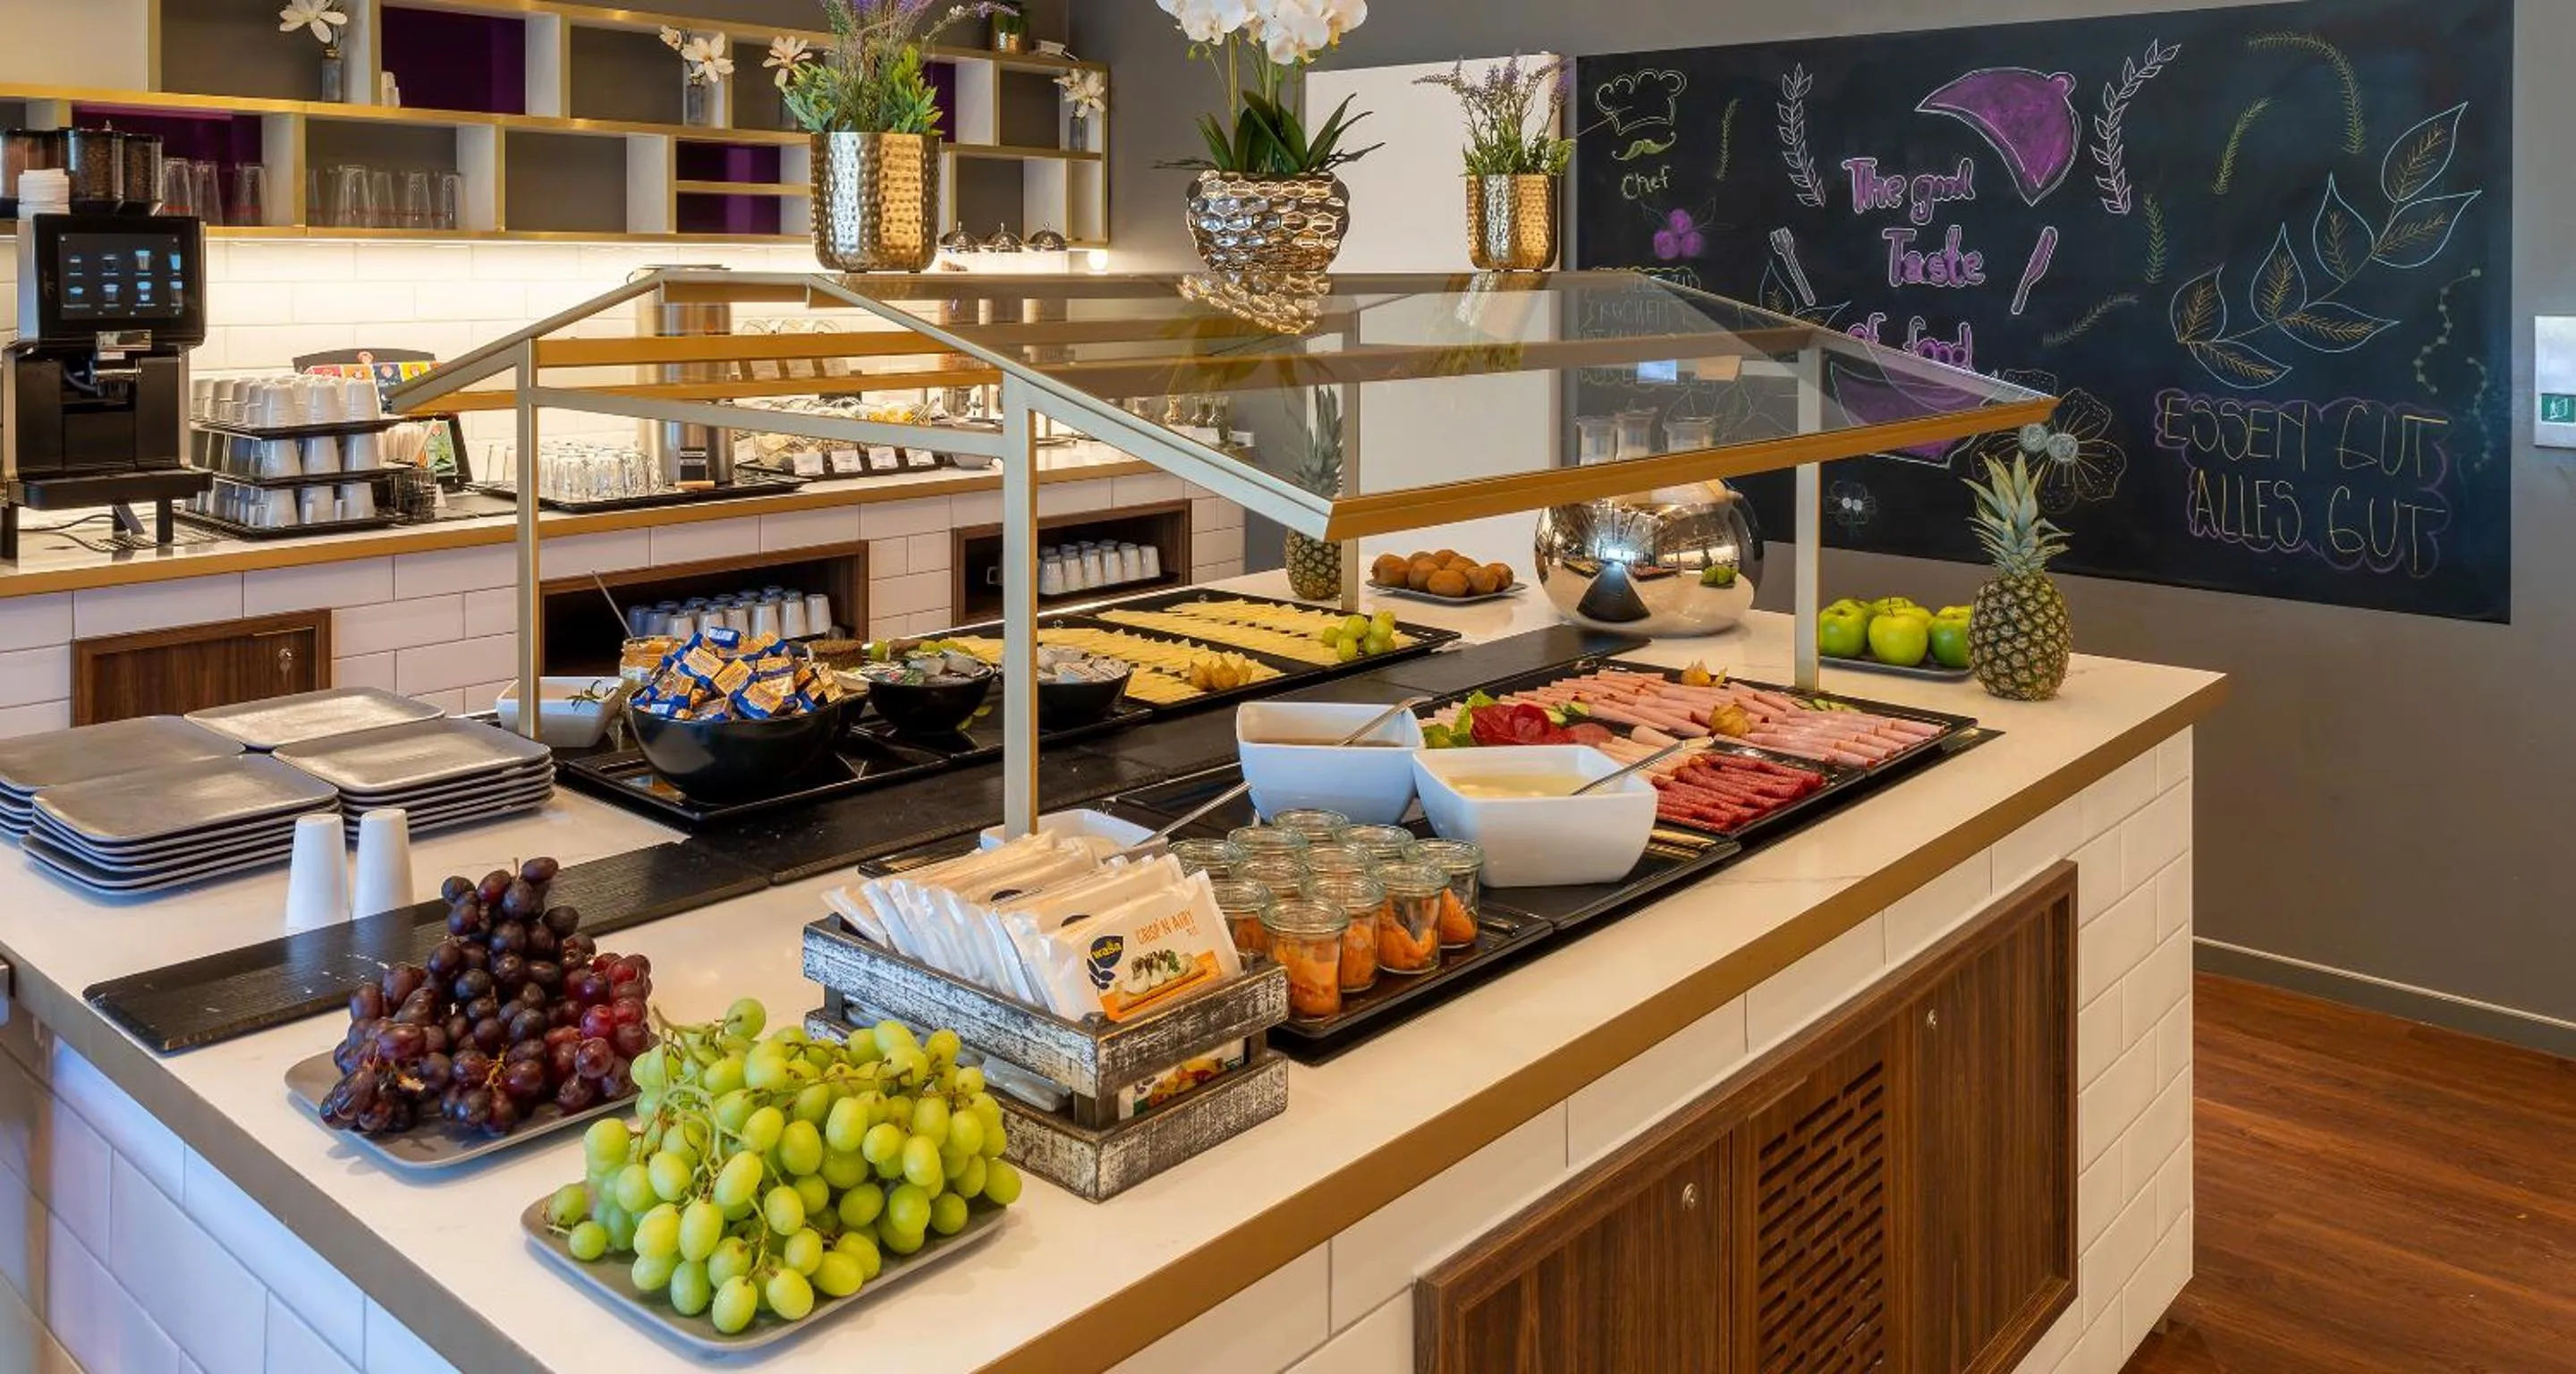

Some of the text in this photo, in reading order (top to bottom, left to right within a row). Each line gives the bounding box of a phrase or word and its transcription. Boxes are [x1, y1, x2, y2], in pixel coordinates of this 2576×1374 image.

[1621, 165, 1671, 200] Chef
[1841, 157, 1976, 225] The good
[1882, 225, 1987, 287] Taste
[1902, 316, 1976, 371] food
[2165, 397, 2449, 478] ESSEN GUT
[2193, 469, 2447, 572] ALLES GUT
